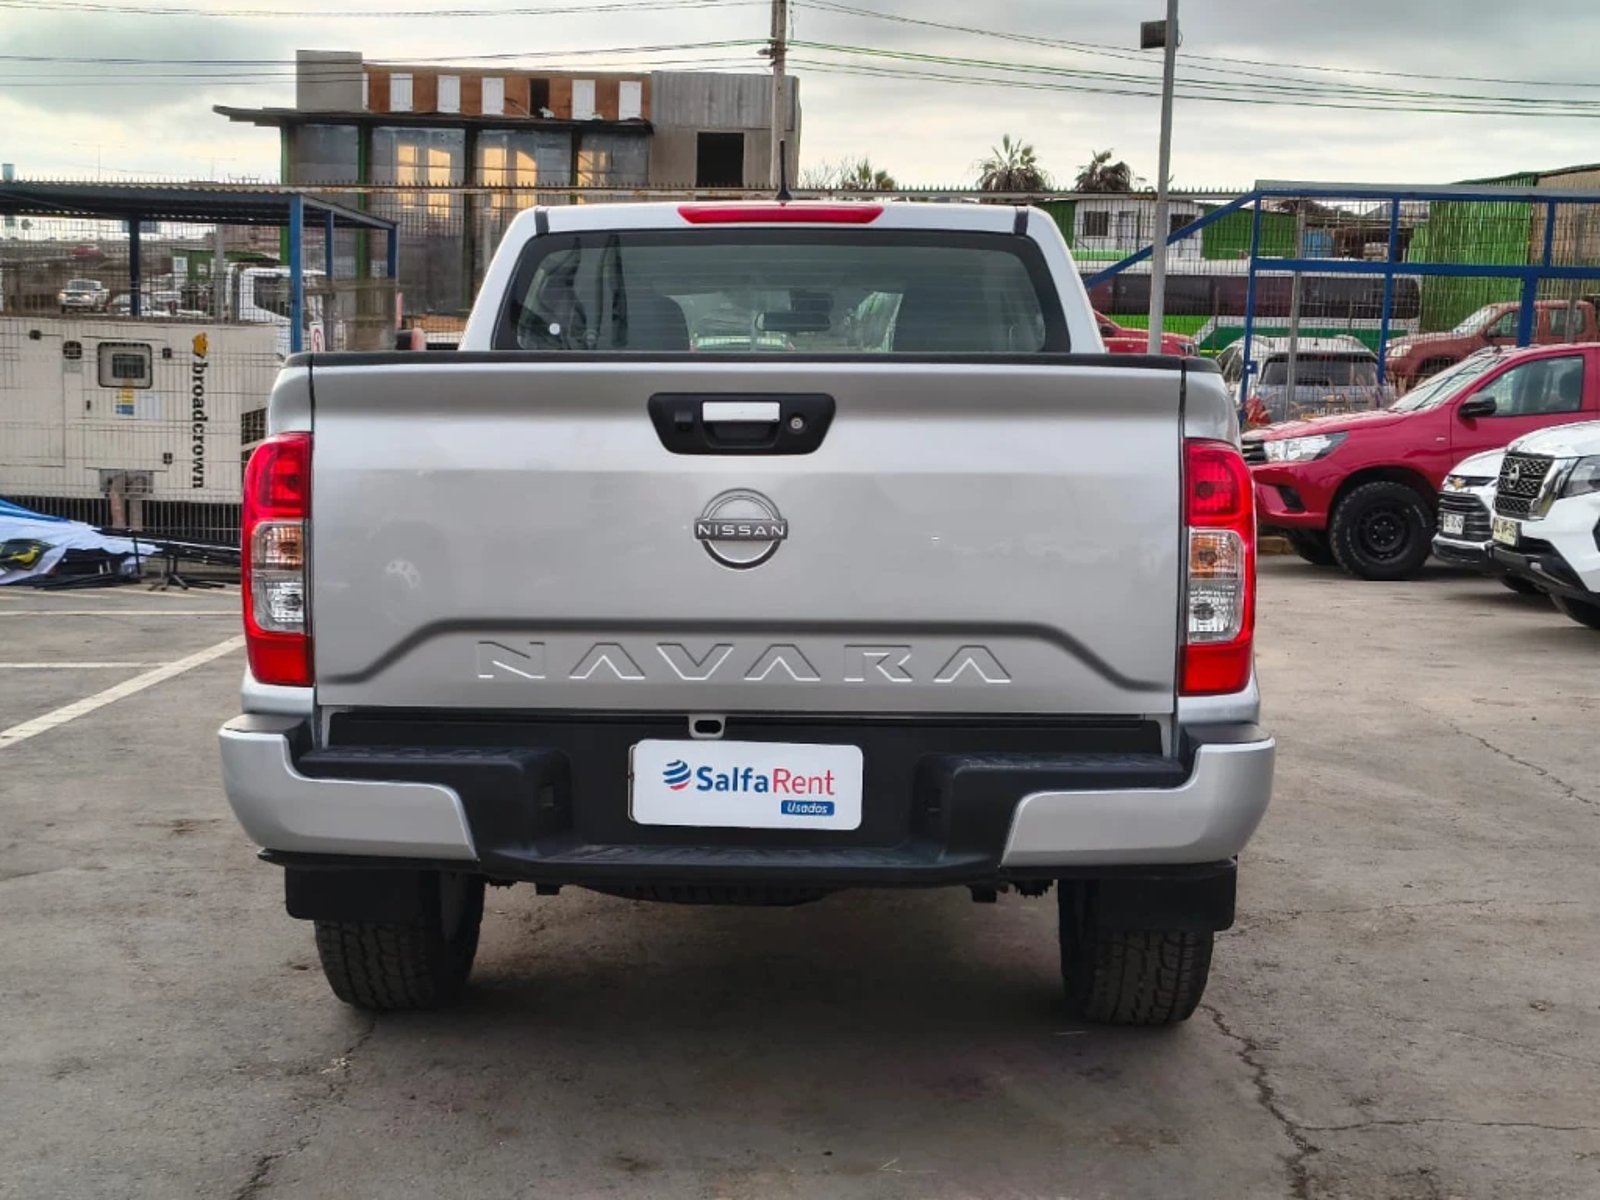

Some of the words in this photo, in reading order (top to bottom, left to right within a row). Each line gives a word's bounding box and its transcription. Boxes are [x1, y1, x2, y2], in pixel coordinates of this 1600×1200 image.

[192, 362, 208, 488] broadcrown
[697, 523, 784, 536] NISSAN
[477, 641, 1012, 682] NAVARA
[696, 766, 836, 795] SalfaRent
[787, 801, 828, 814] Usados
